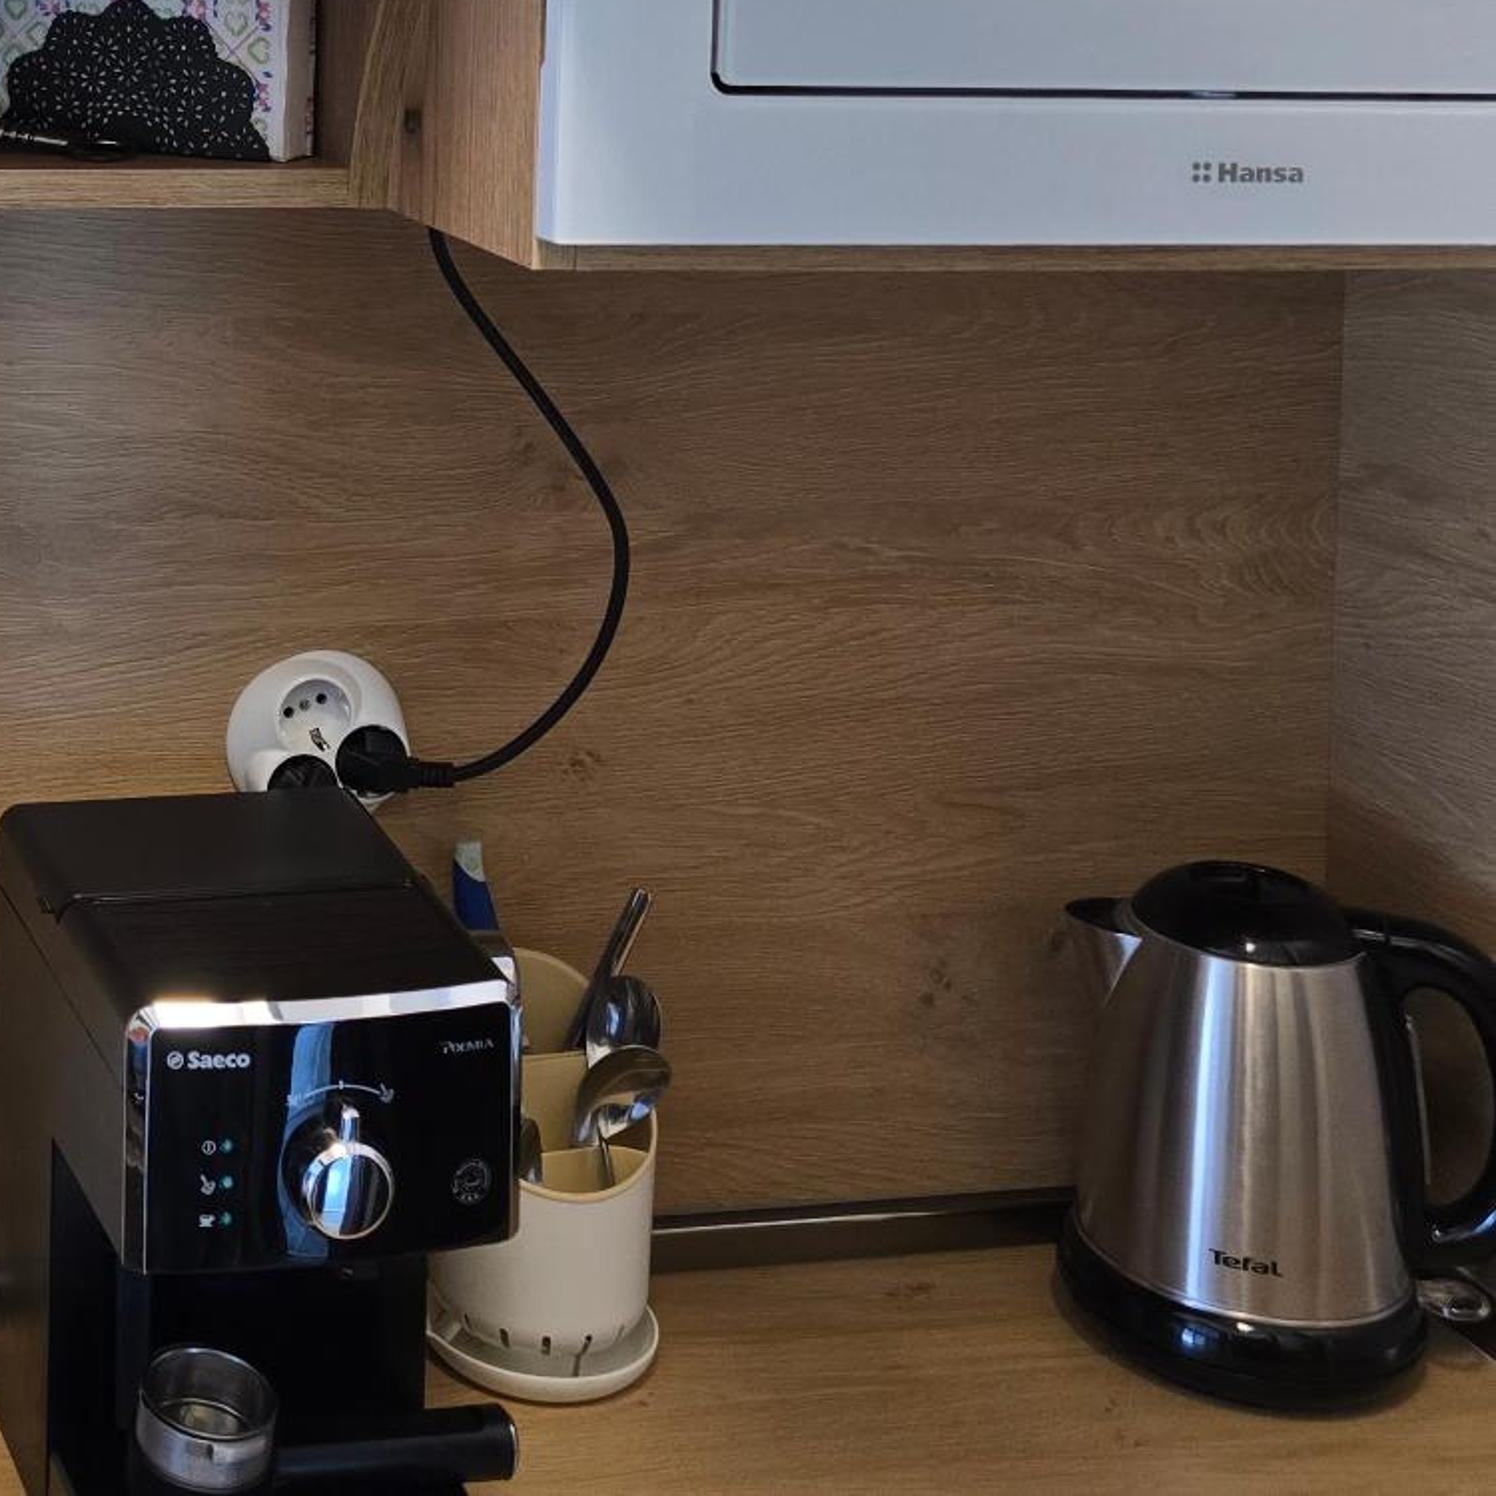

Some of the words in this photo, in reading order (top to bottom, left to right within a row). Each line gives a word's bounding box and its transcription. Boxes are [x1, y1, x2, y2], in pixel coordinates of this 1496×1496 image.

[1217, 162, 1304, 184] Hansa
[187, 1050, 250, 1070] Saeco
[1208, 1247, 1283, 1278] Tefal
